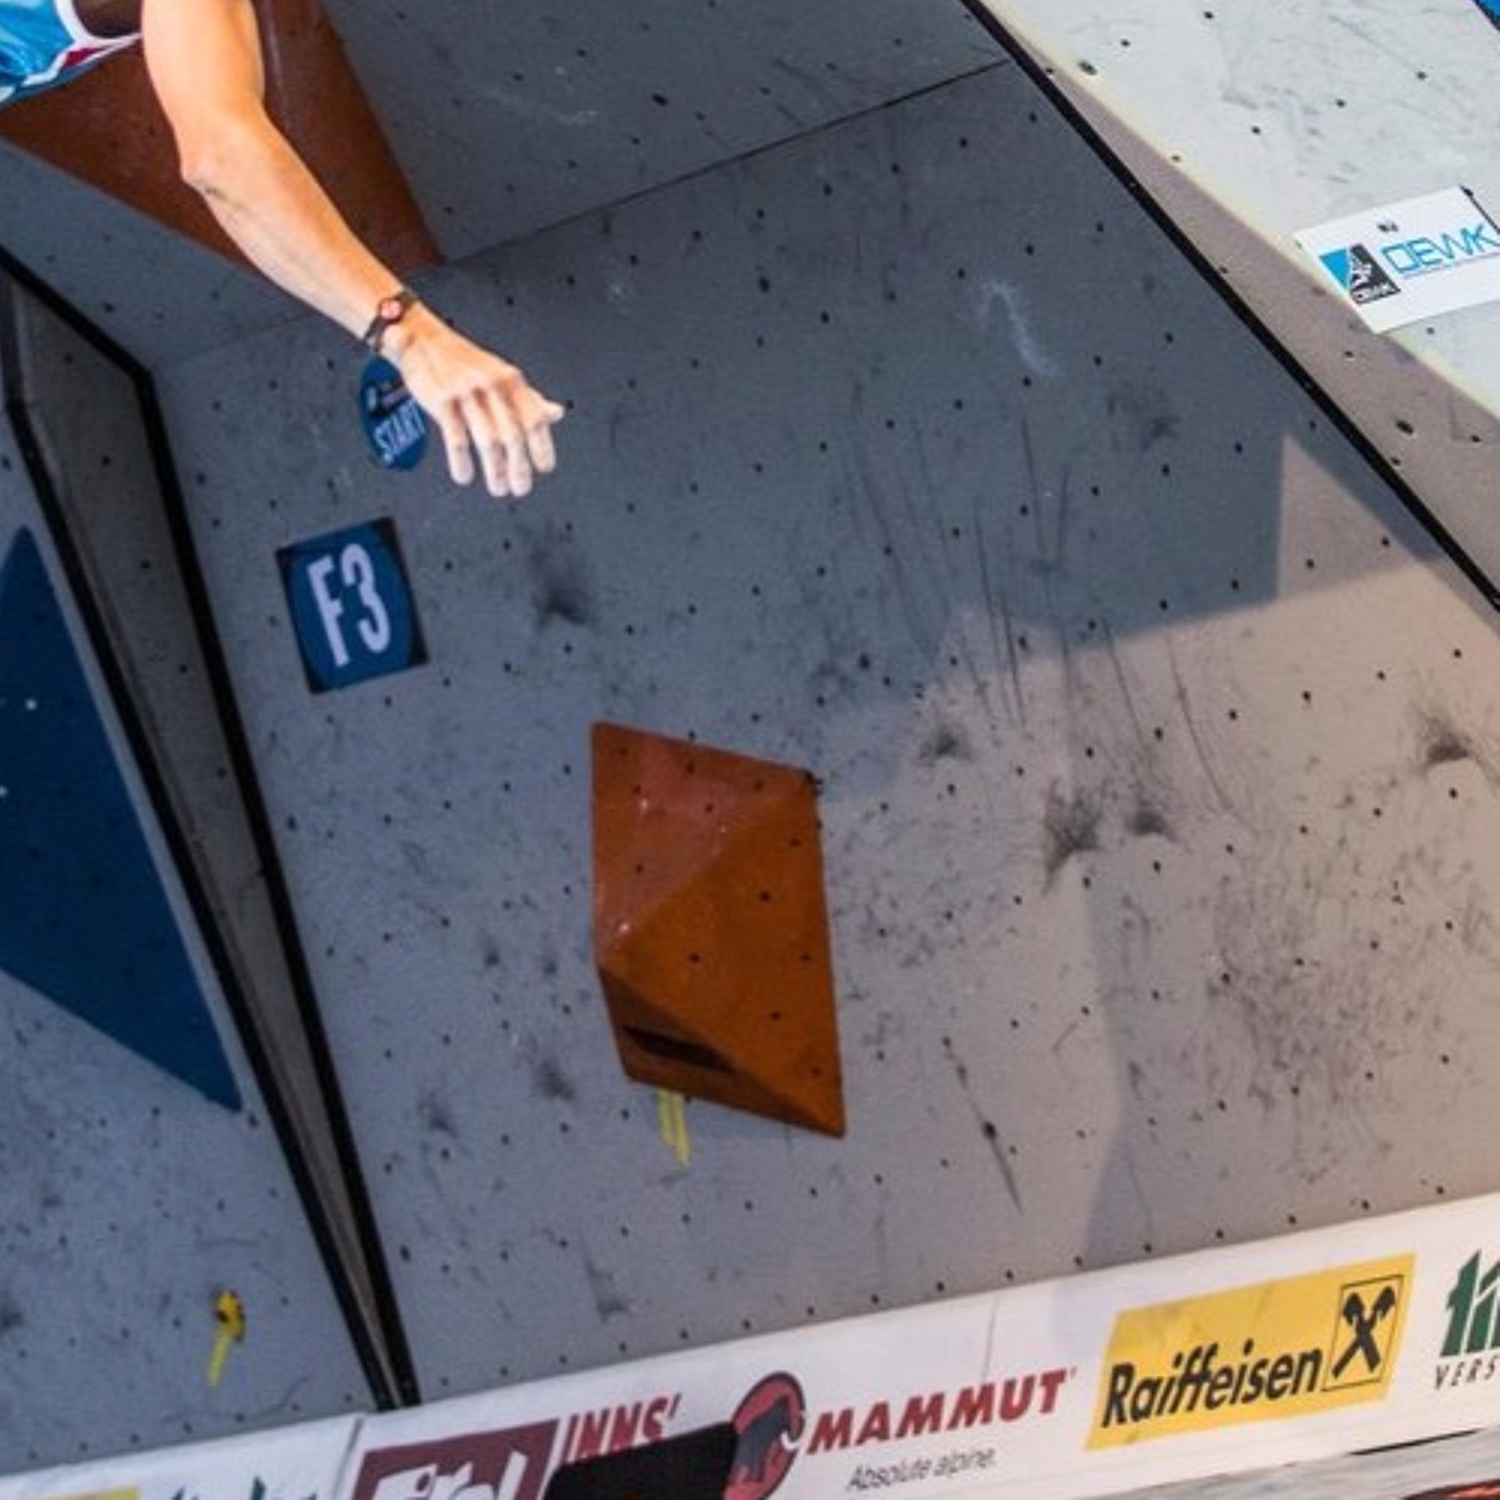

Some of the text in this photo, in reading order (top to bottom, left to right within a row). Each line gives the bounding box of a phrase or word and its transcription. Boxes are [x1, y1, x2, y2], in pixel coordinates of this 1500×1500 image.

[374, 399, 426, 464] START
[306, 543, 393, 667] F3
[807, 1367, 1068, 1455] MAMMUT
[1101, 1340, 1323, 1429] Raiffeisen
[847, 1458, 931, 1492] Absolute
